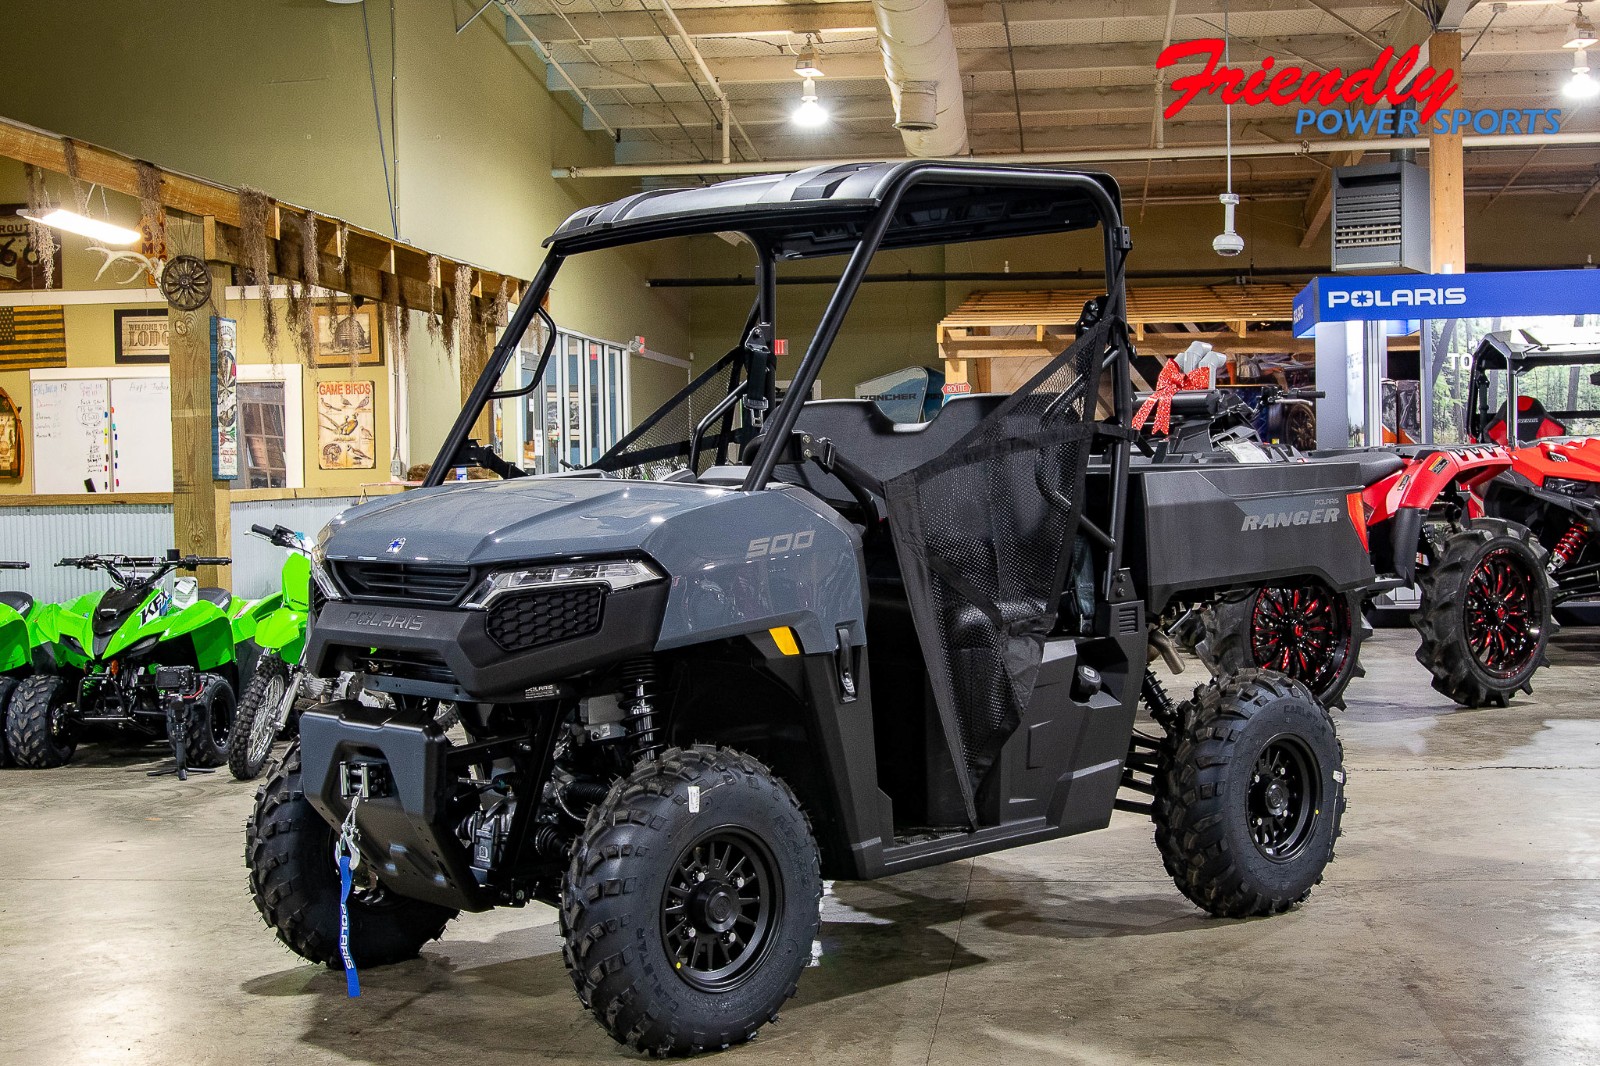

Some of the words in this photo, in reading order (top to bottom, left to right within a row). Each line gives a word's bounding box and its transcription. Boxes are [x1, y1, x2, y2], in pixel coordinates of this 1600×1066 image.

[0, 223, 31, 234] ROUT
[1328, 287, 1467, 308] POLARIS
[128, 323, 158, 331] WELCOME
[159, 323, 168, 331] TO
[319, 383, 344, 395] GAME
[345, 383, 371, 395] BIRDS
[946, 385, 967, 393] ROUTE
[1314, 498, 1340, 506] POLARIS
[1241, 507, 1340, 532] RANGER
[746, 530, 816, 559] 500
[141, 591, 169, 627] KFX
[345, 610, 423, 631] POLARIS
[340, 904, 355, 970] POLARIS
